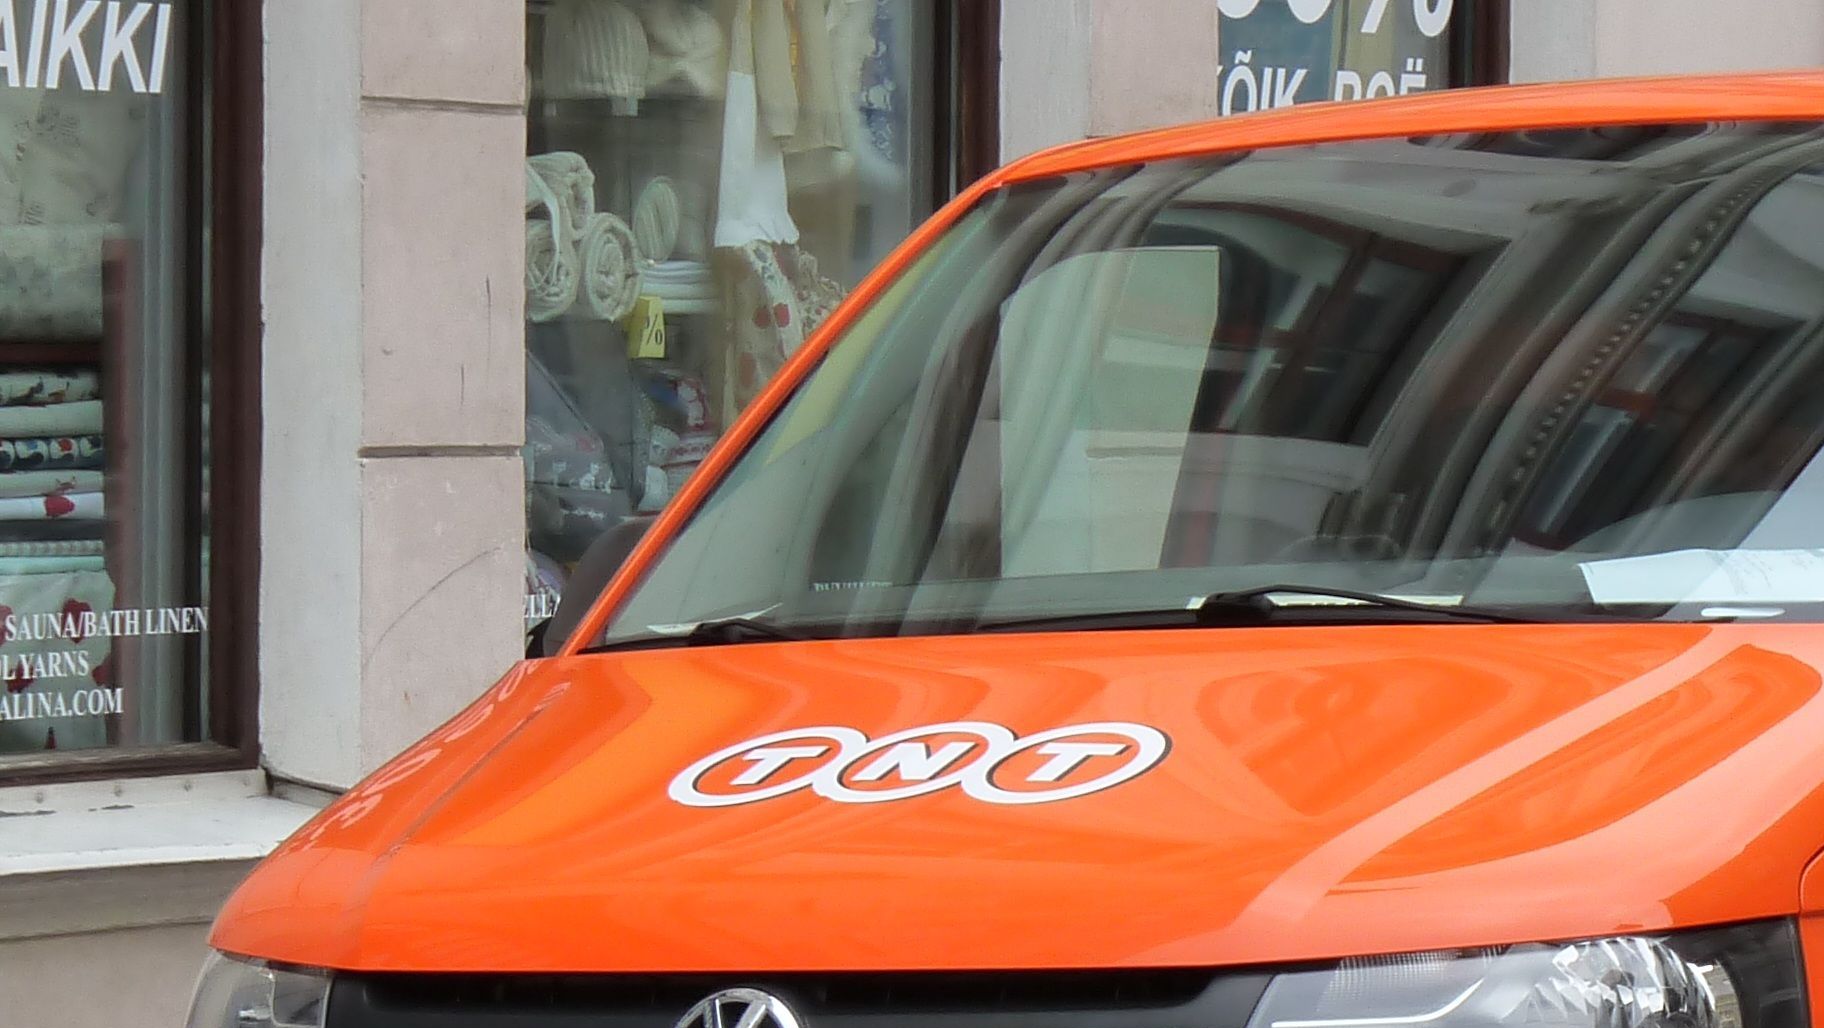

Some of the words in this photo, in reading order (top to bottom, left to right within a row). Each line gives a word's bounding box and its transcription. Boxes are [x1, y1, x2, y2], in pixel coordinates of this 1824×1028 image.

[5, 607, 139, 642] SAUNA/BATH
[145, 606, 209, 635] LINEN
[19, 650, 89, 680] YARNS
